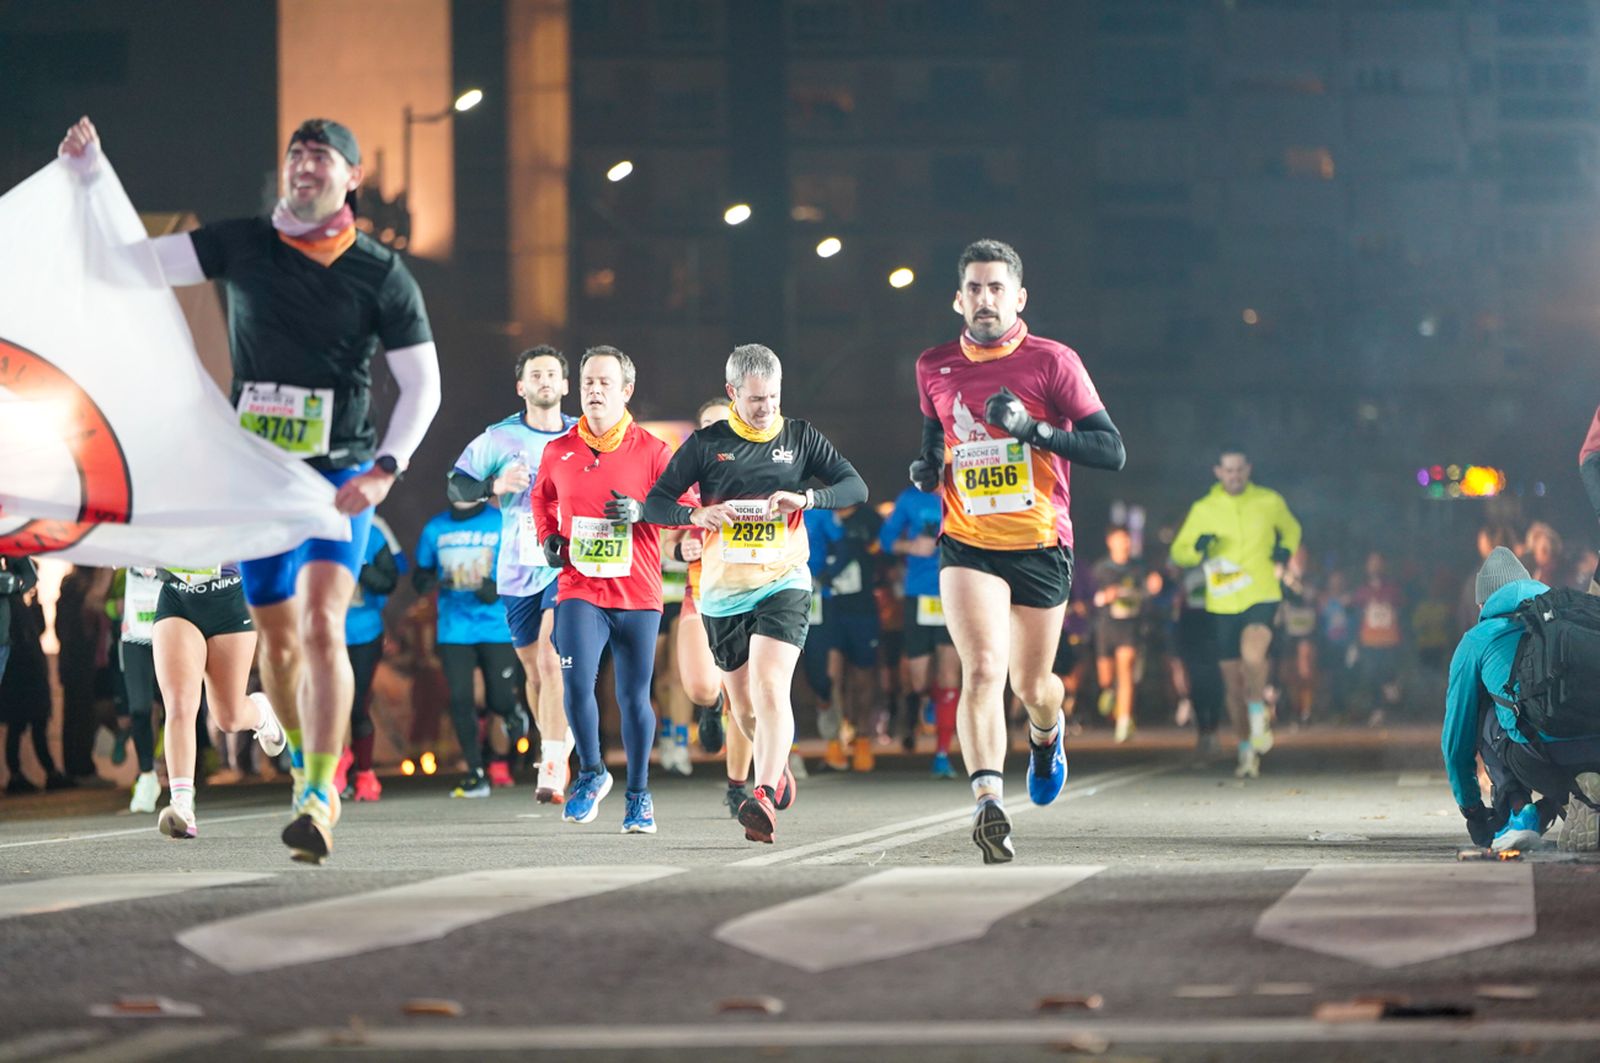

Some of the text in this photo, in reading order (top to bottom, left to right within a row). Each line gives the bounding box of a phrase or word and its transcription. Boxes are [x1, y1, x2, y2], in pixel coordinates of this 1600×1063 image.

[255, 415, 309, 444] 3747
[967, 449, 989, 458] NOCHE
[990, 447, 999, 456] DE
[960, 459, 974, 469] SAN
[965, 465, 1018, 490] 8456
[732, 522, 776, 542] 2329
[578, 539, 623, 557] 12257
[178, 576, 243, 594] PRO NIKE
